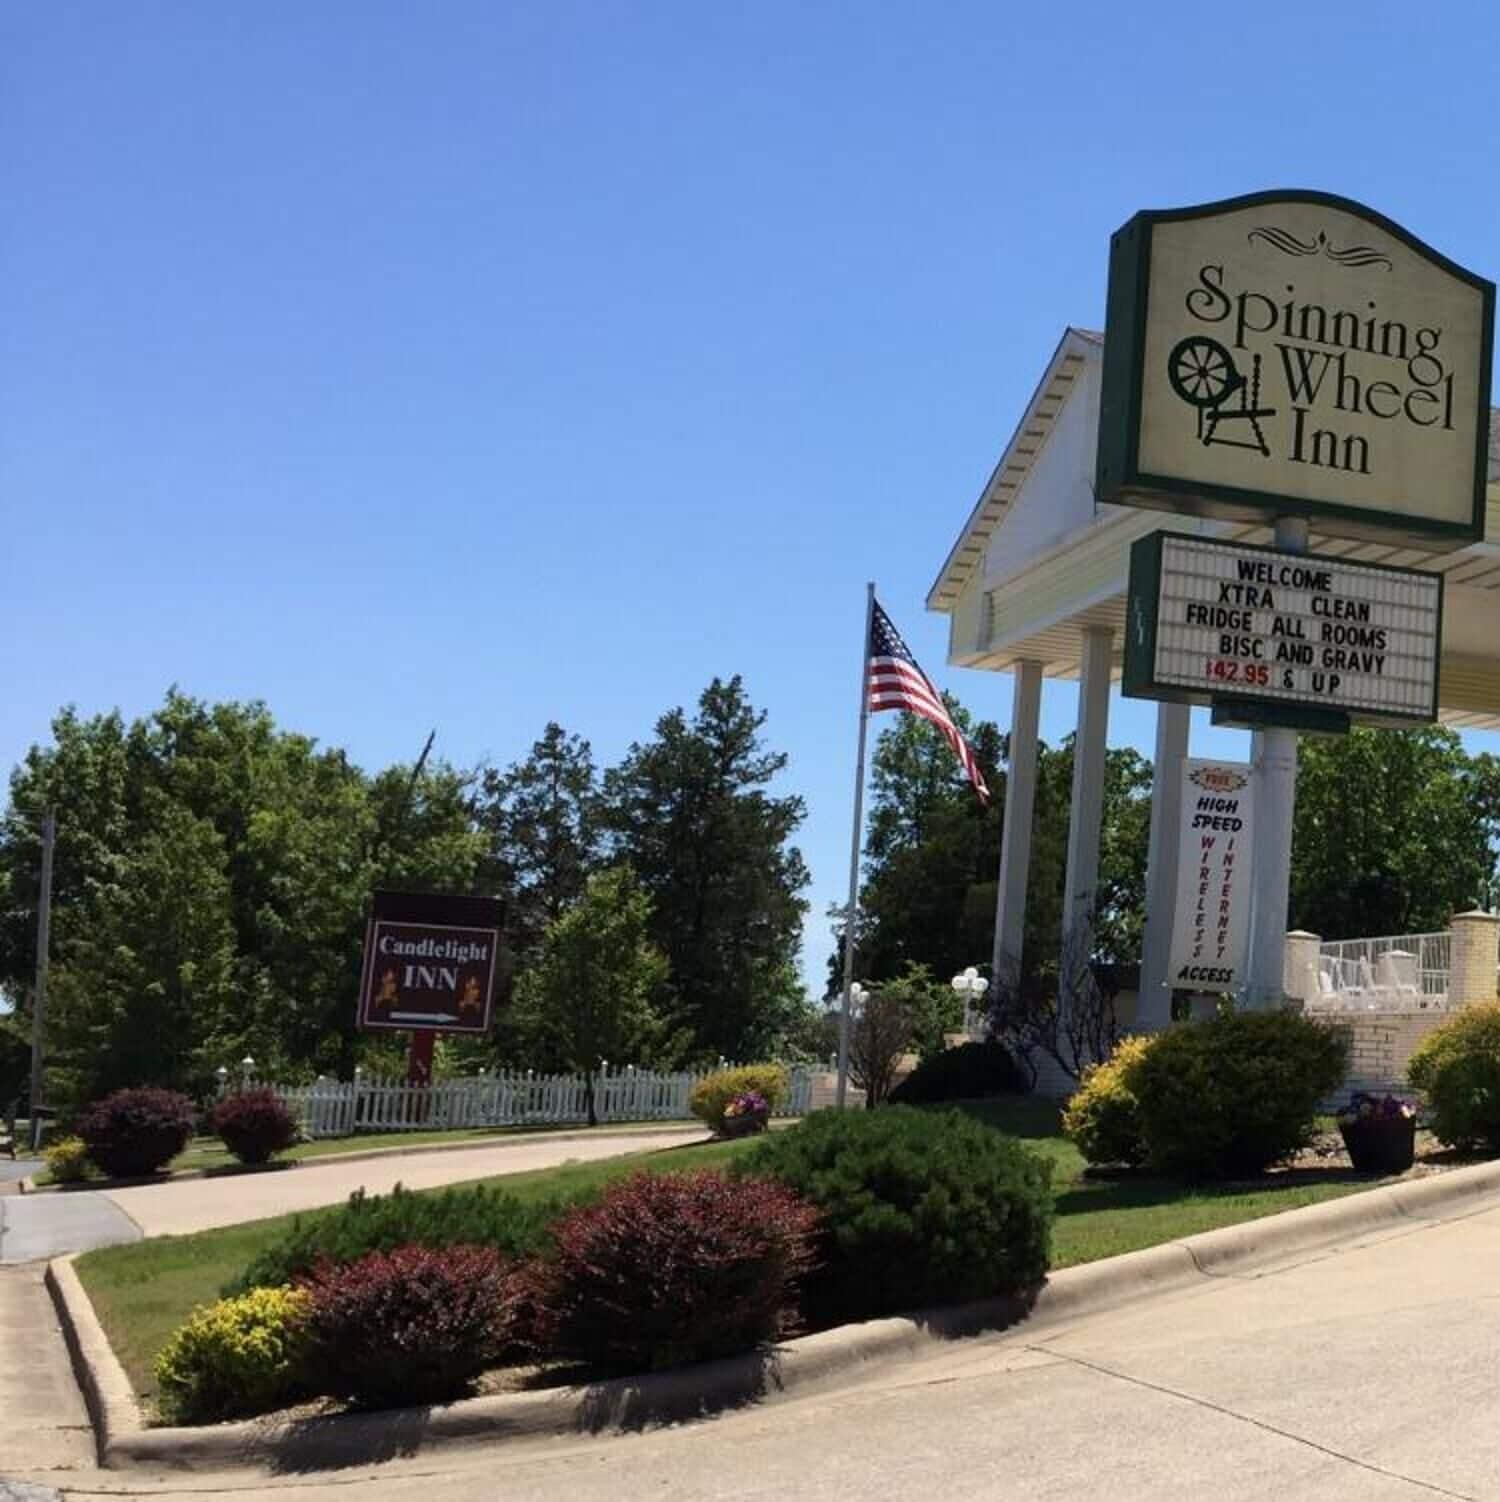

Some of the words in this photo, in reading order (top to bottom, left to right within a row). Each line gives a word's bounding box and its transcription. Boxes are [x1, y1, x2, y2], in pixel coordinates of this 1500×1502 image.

[1185, 264, 1443, 387] Spinning
[1274, 342, 1455, 430] Wheel
[1288, 406, 1372, 474] Inn
[1237, 559, 1332, 592] WELCOME
[1219, 583, 1274, 609] XTRA
[1311, 597, 1370, 622] CLEAN
[1187, 604, 1252, 632] FRIDGE
[1271, 616, 1306, 640] ALL
[1322, 622, 1387, 650] ROOMS
[1219, 634, 1263, 658] BISC
[1276, 641, 1314, 665] AND
[1322, 647, 1386, 675] GRAVY
[1206, 661, 1269, 687] $42.95
[1283, 670, 1295, 689] &
[1312, 672, 1341, 695] UP
[1192, 813, 1243, 832] SPEED
[1197, 797, 1239, 815] HIGH
[1192, 835, 1216, 959] WIRELESS
[1216, 836, 1234, 959] INTERNET
[379, 935, 489, 963] Candlelight
[403, 964, 459, 992] INN
[1177, 966, 1234, 984] ACCESS
